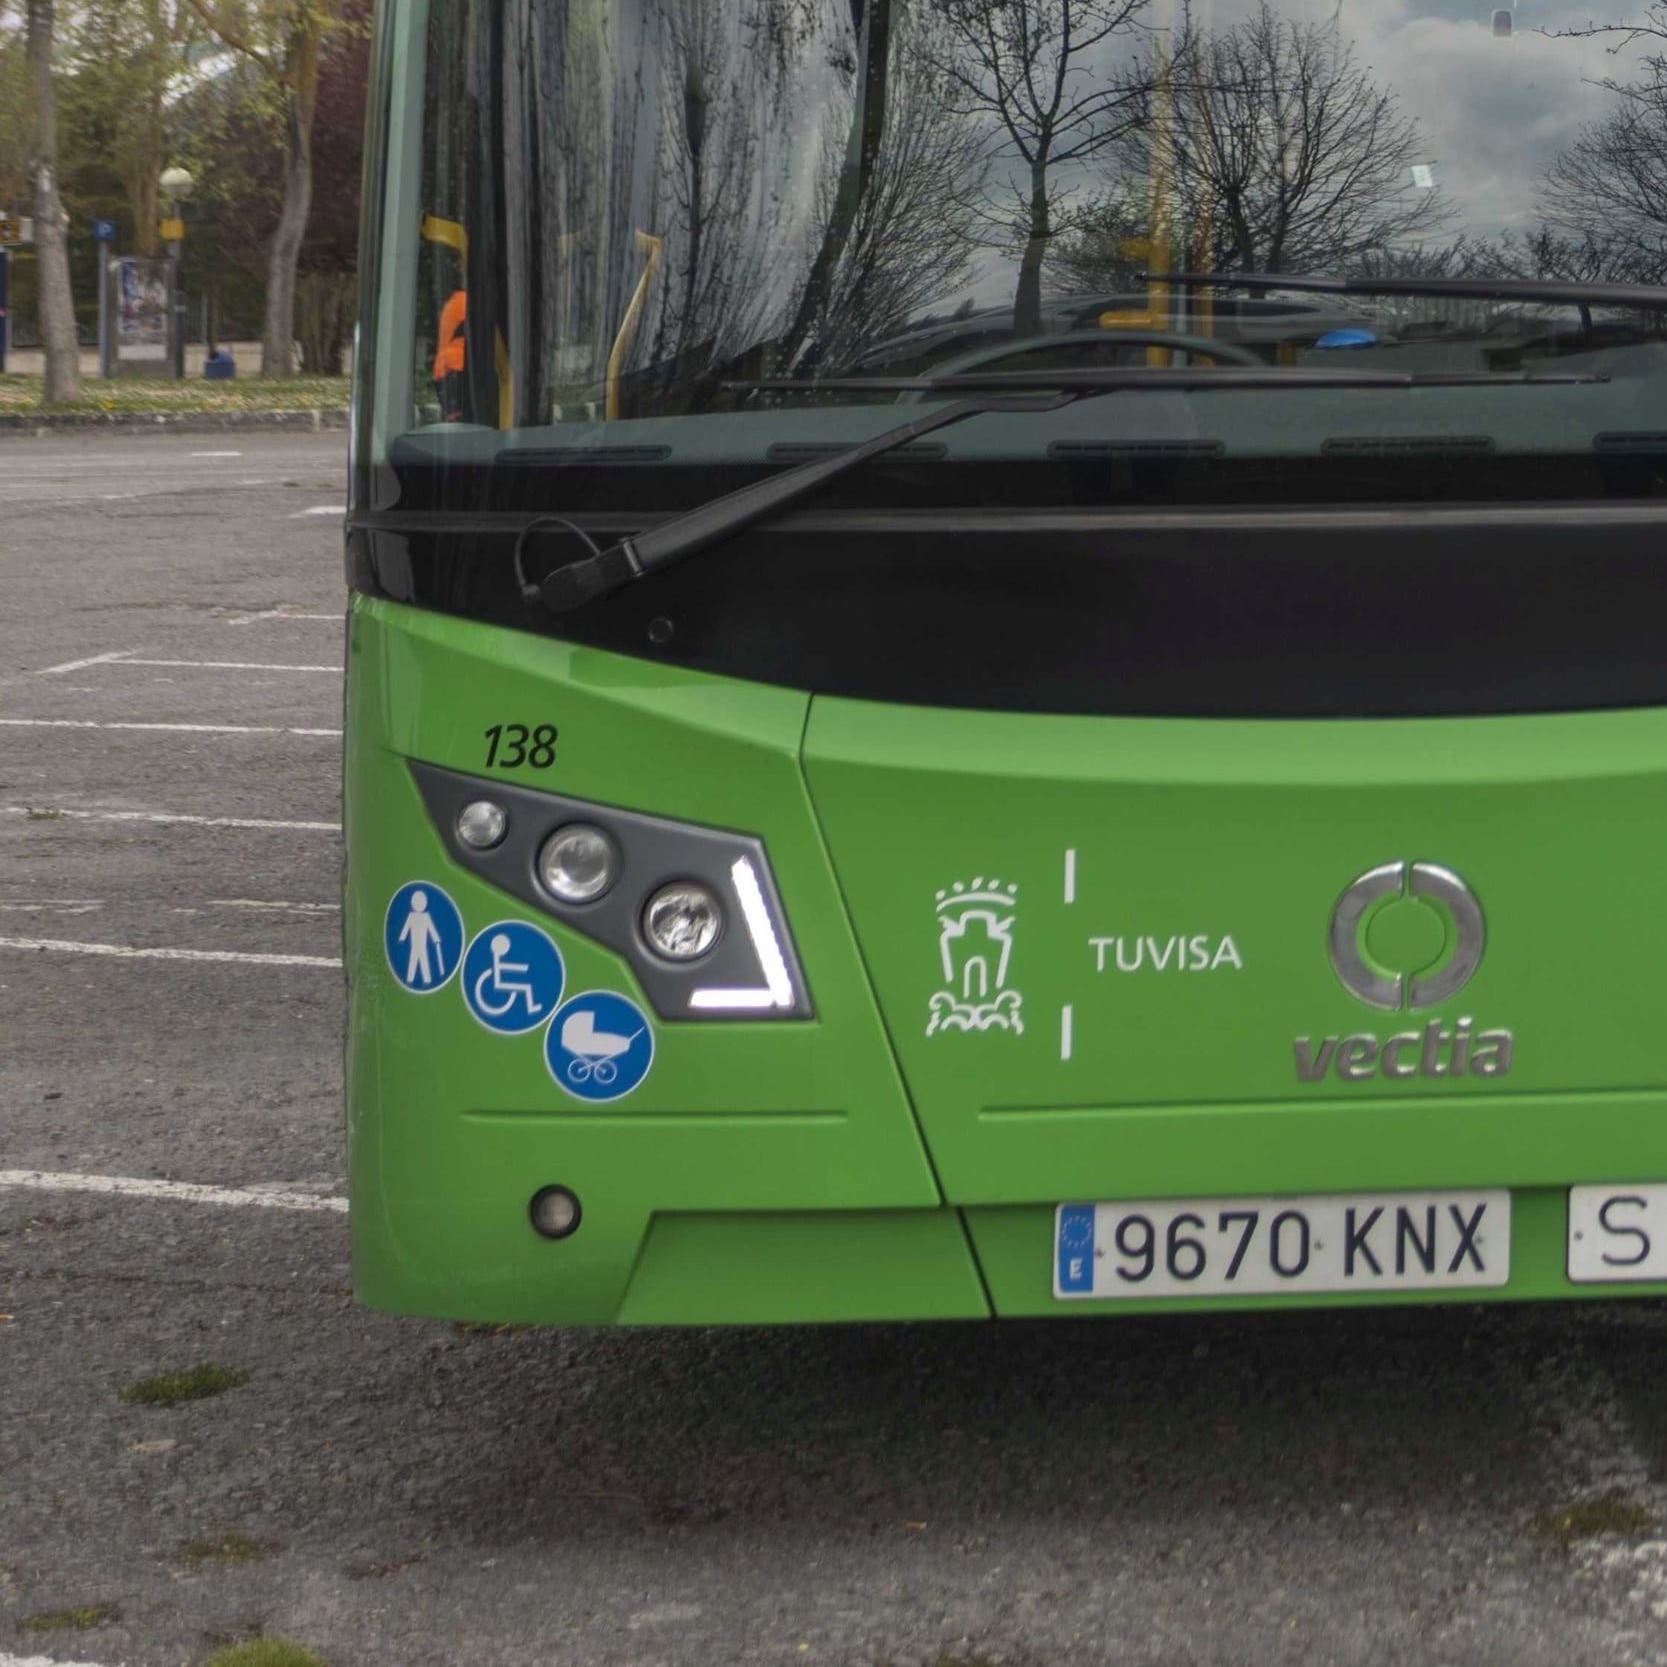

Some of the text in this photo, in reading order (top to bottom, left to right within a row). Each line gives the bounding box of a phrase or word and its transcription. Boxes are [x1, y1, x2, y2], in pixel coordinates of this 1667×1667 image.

[482, 724, 558, 769] 138
[1088, 936, 1243, 973] TUVISA
[1293, 1015, 1514, 1083] vectia
[1114, 1203, 1487, 1283] 9670 KNX
[1069, 1258, 1083, 1280] E
